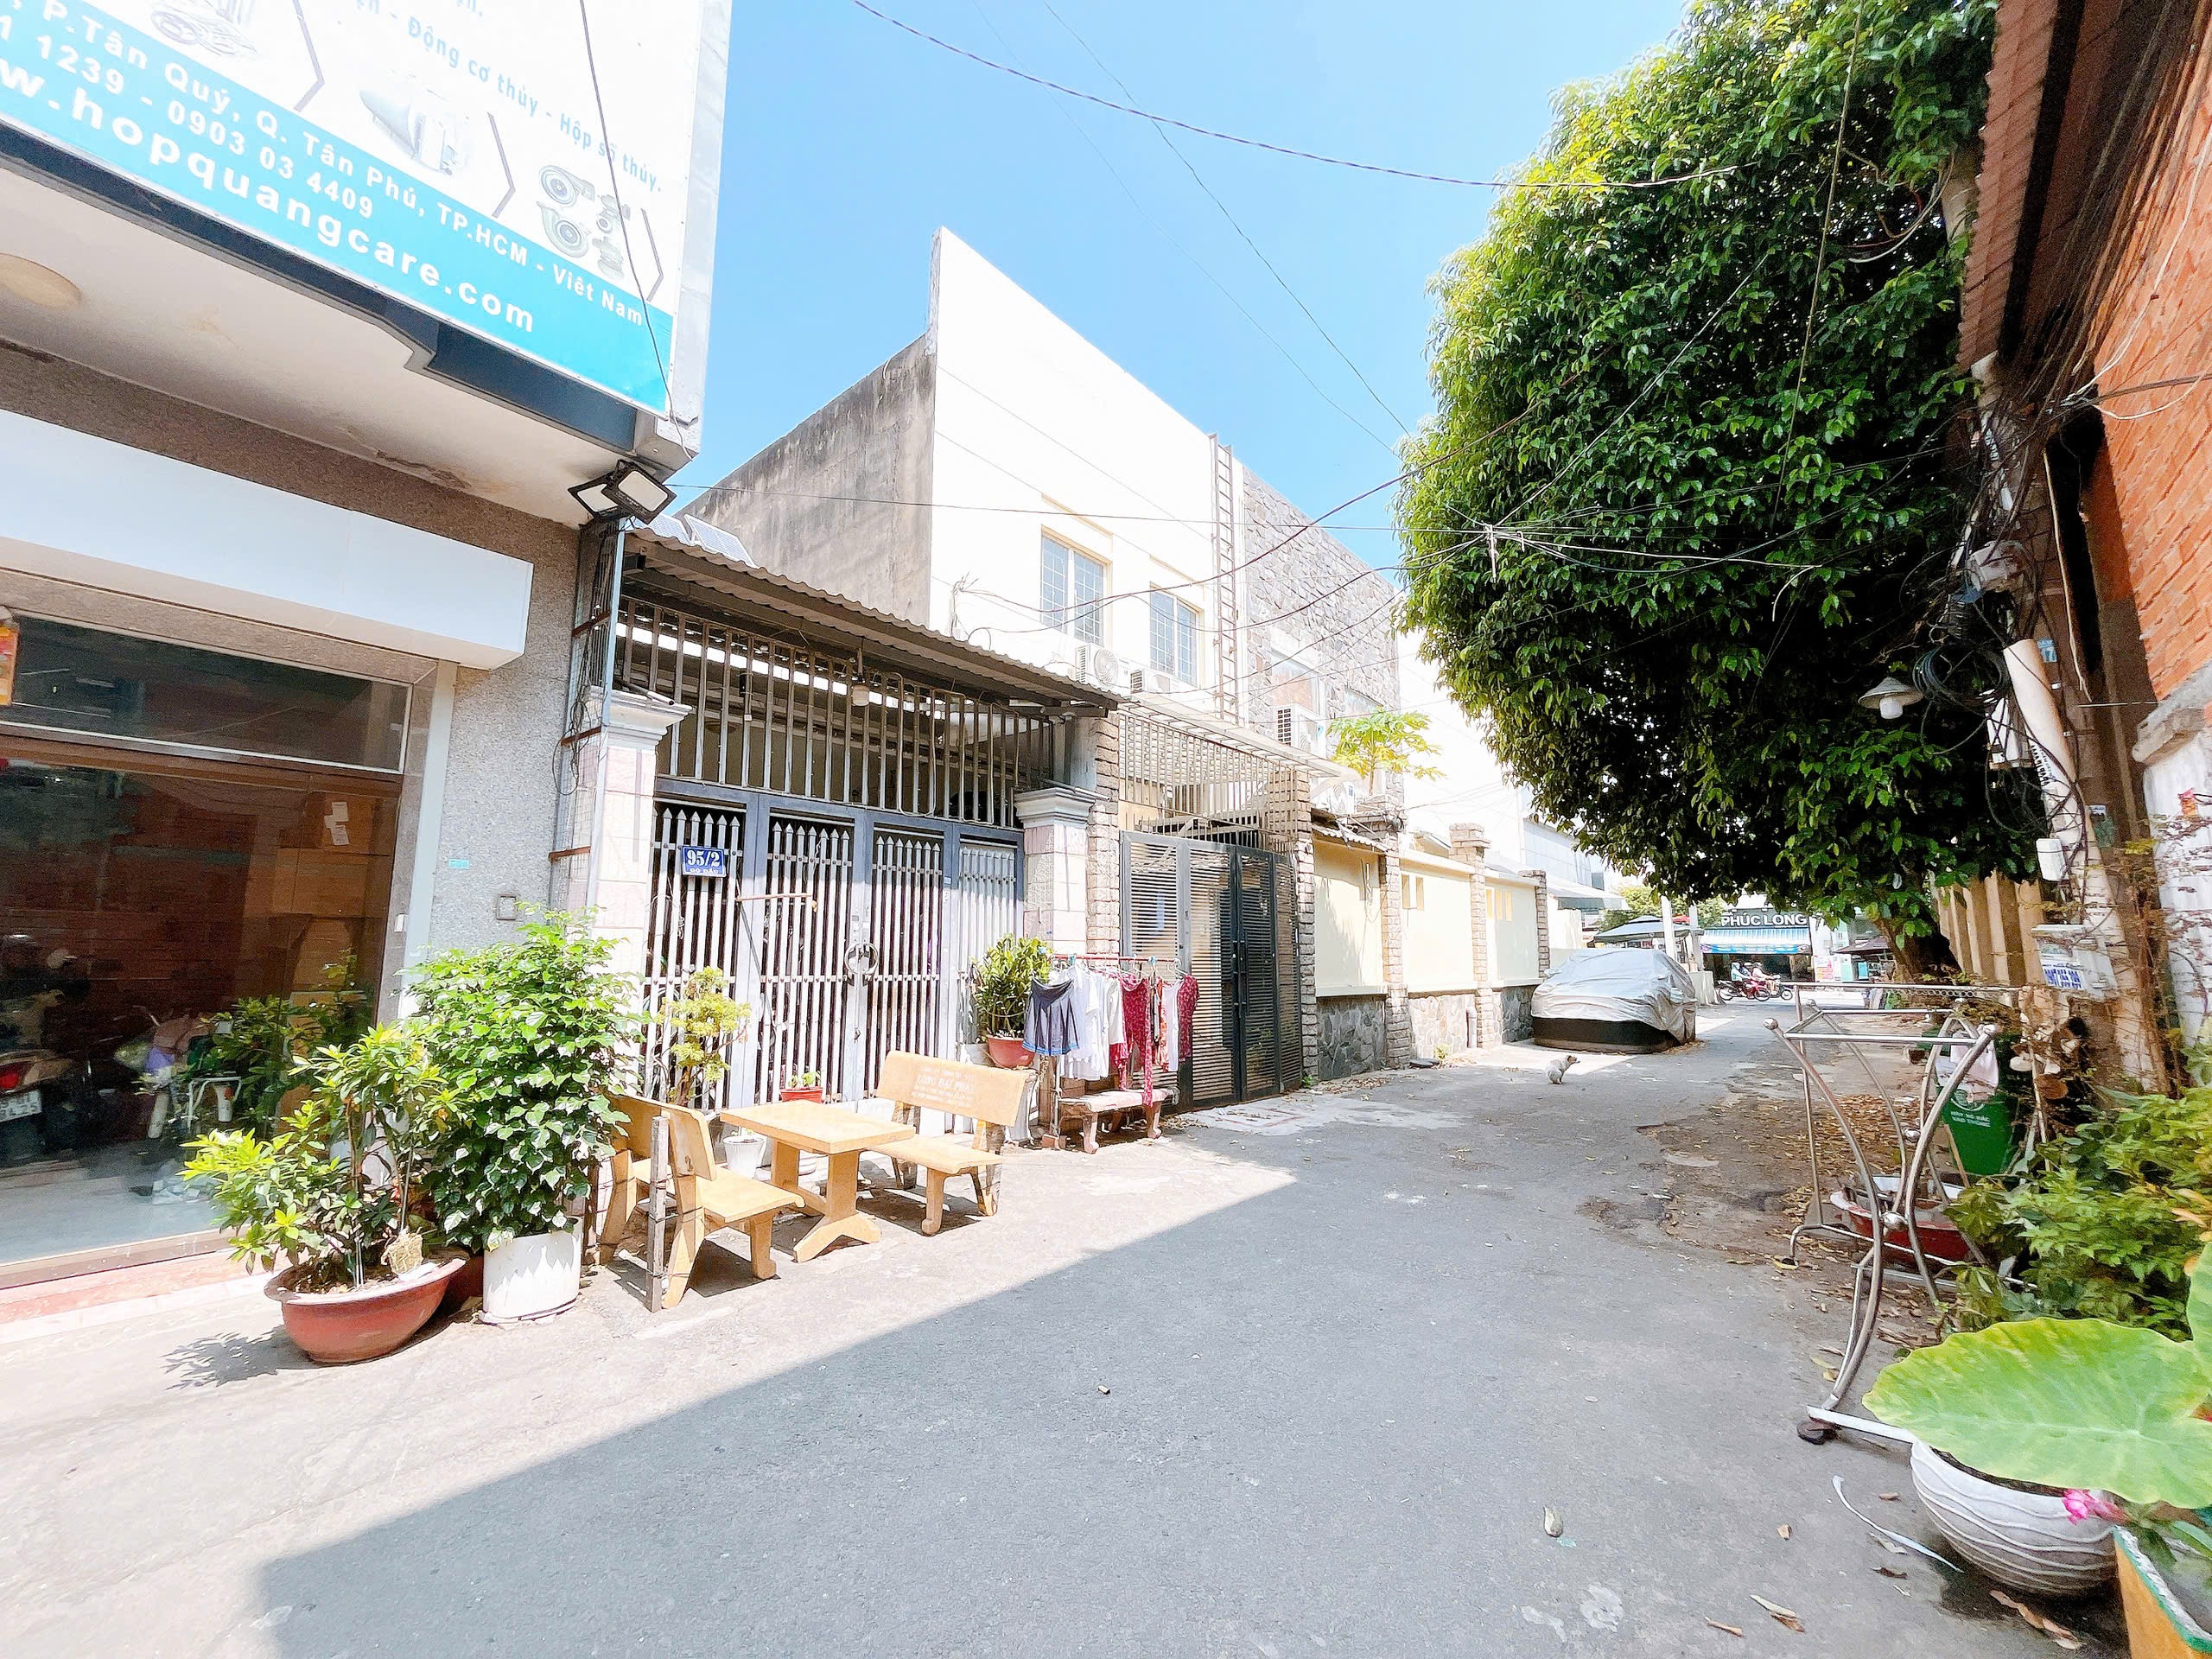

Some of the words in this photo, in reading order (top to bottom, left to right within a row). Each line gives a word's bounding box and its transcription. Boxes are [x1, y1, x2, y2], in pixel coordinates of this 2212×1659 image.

[37, 35, 124, 95] 1239
[168, 100, 245, 156] 0903
[259, 146, 294, 180] 03
[306, 172, 373, 218] 4409
[408, 16, 460, 68] Động
[560, 112, 592, 149] Hộp
[257, 110, 287, 144] Q.
[303, 131, 354, 176] Tân
[437, 202, 528, 266] TP.HCM
[601, 289, 643, 326] Nam
[686, 849, 721, 868] 95/2
[1721, 912, 1761, 927] PHÚC
[1764, 913, 1808, 926] LONG
